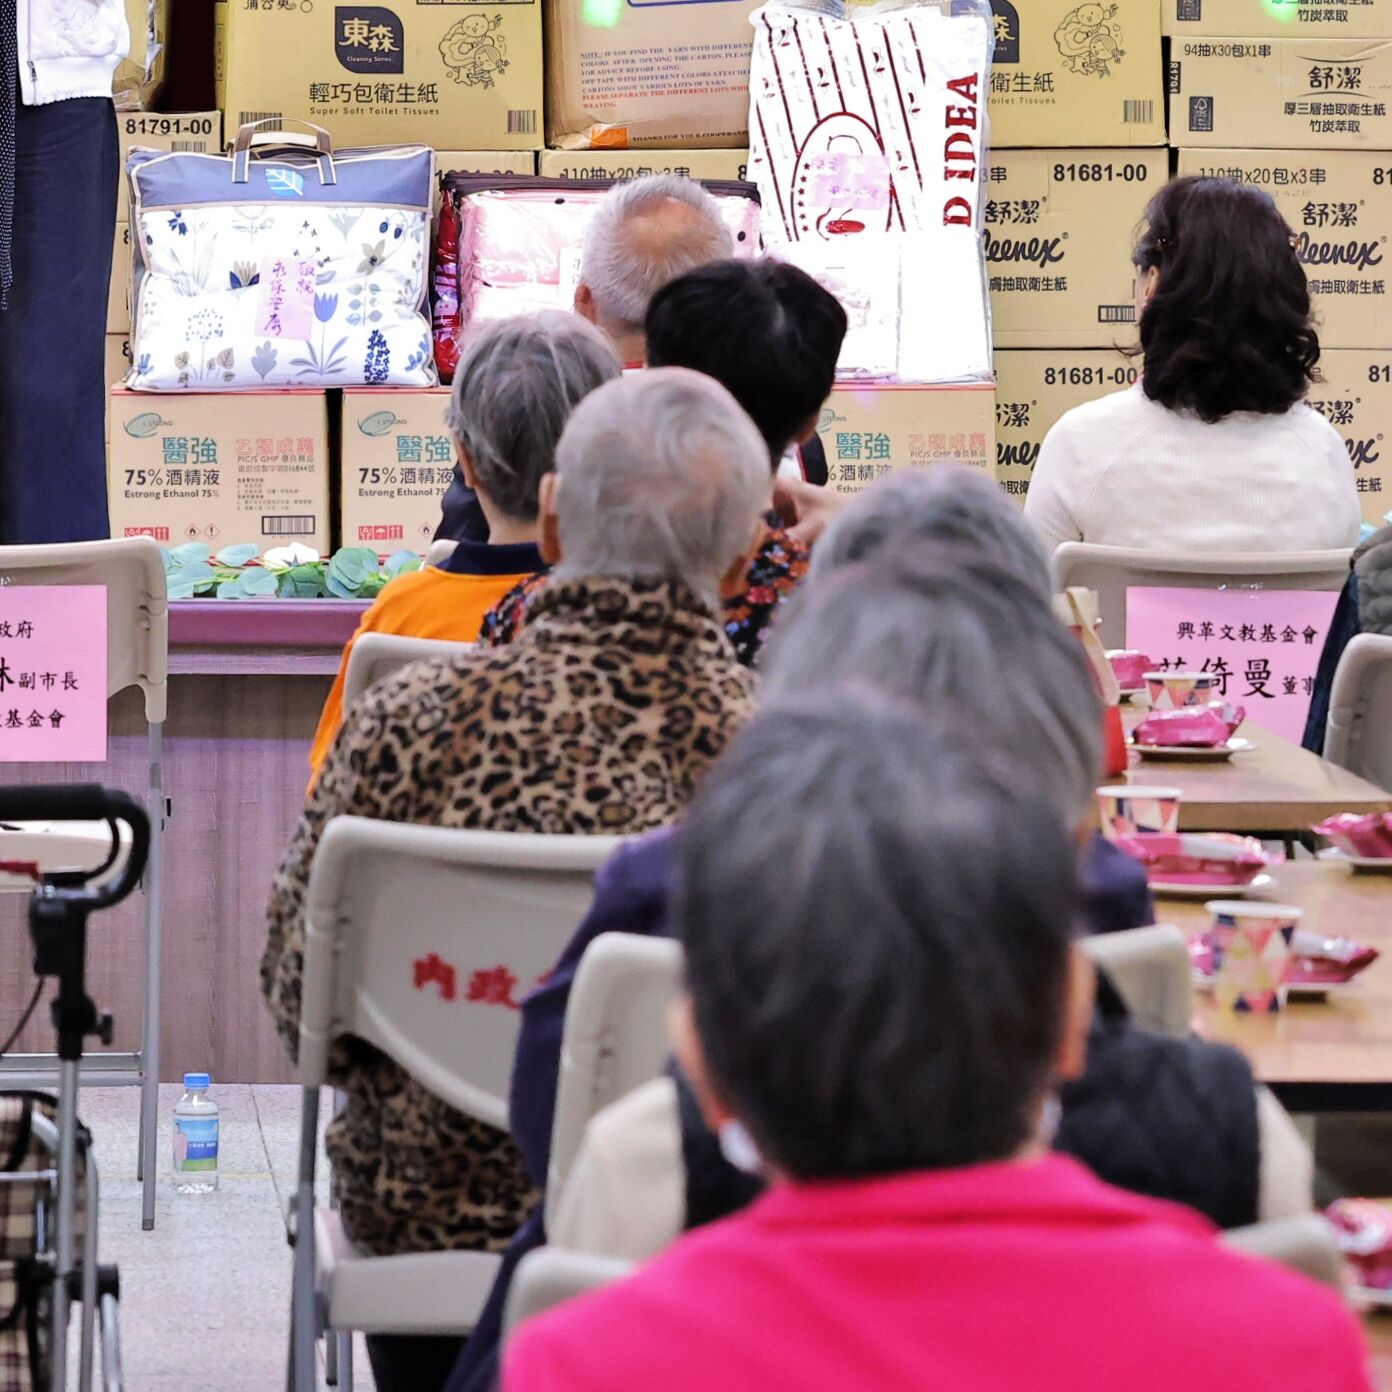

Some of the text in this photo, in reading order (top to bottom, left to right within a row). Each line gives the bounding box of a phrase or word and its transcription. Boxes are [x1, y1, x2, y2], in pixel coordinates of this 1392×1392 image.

[1297, 10, 1348, 22] 竹炭萃取
[338, 16, 400, 53] 東森
[347, 55, 392, 63] Cleaning Series
[1184, 43, 1271, 58] 94抽X30包X1串
[990, 72, 1055, 93] 衛生紙
[1308, 66, 1362, 90] 舒潔
[308, 82, 439, 104] 輕巧包衛生紙
[1019, 97, 1056, 105] Tissues
[310, 107, 440, 116] Super Soft Toilet Tissues
[1284, 103, 1386, 116] 厚三層抽取衛生紙
[125, 118, 212, 135] 81791-00
[943, 72, 980, 183] IDEA
[1310, 120, 1360, 133] 竹炭萃取
[1053, 164, 1147, 183] 81681-00
[985, 199, 1040, 225] 舒潔
[1302, 201, 1359, 227] 舒潔
[984, 231, 1065, 267] leenex
[1298, 234, 1384, 270] leenex
[1044, 367, 1138, 385] 81681-00
[162, 437, 218, 464] 醫強
[396, 436, 452, 464] 醫強
[836, 432, 891, 459] 醫強
[125, 469, 220, 486] 75%酒精液
[125, 490, 220, 500] Estrong Ethanol 75%
[358, 487, 433, 498] Estrong Ethanol
[1176, 622, 1319, 645] 興革文教基金會
[18, 671, 79, 691] 副市長
